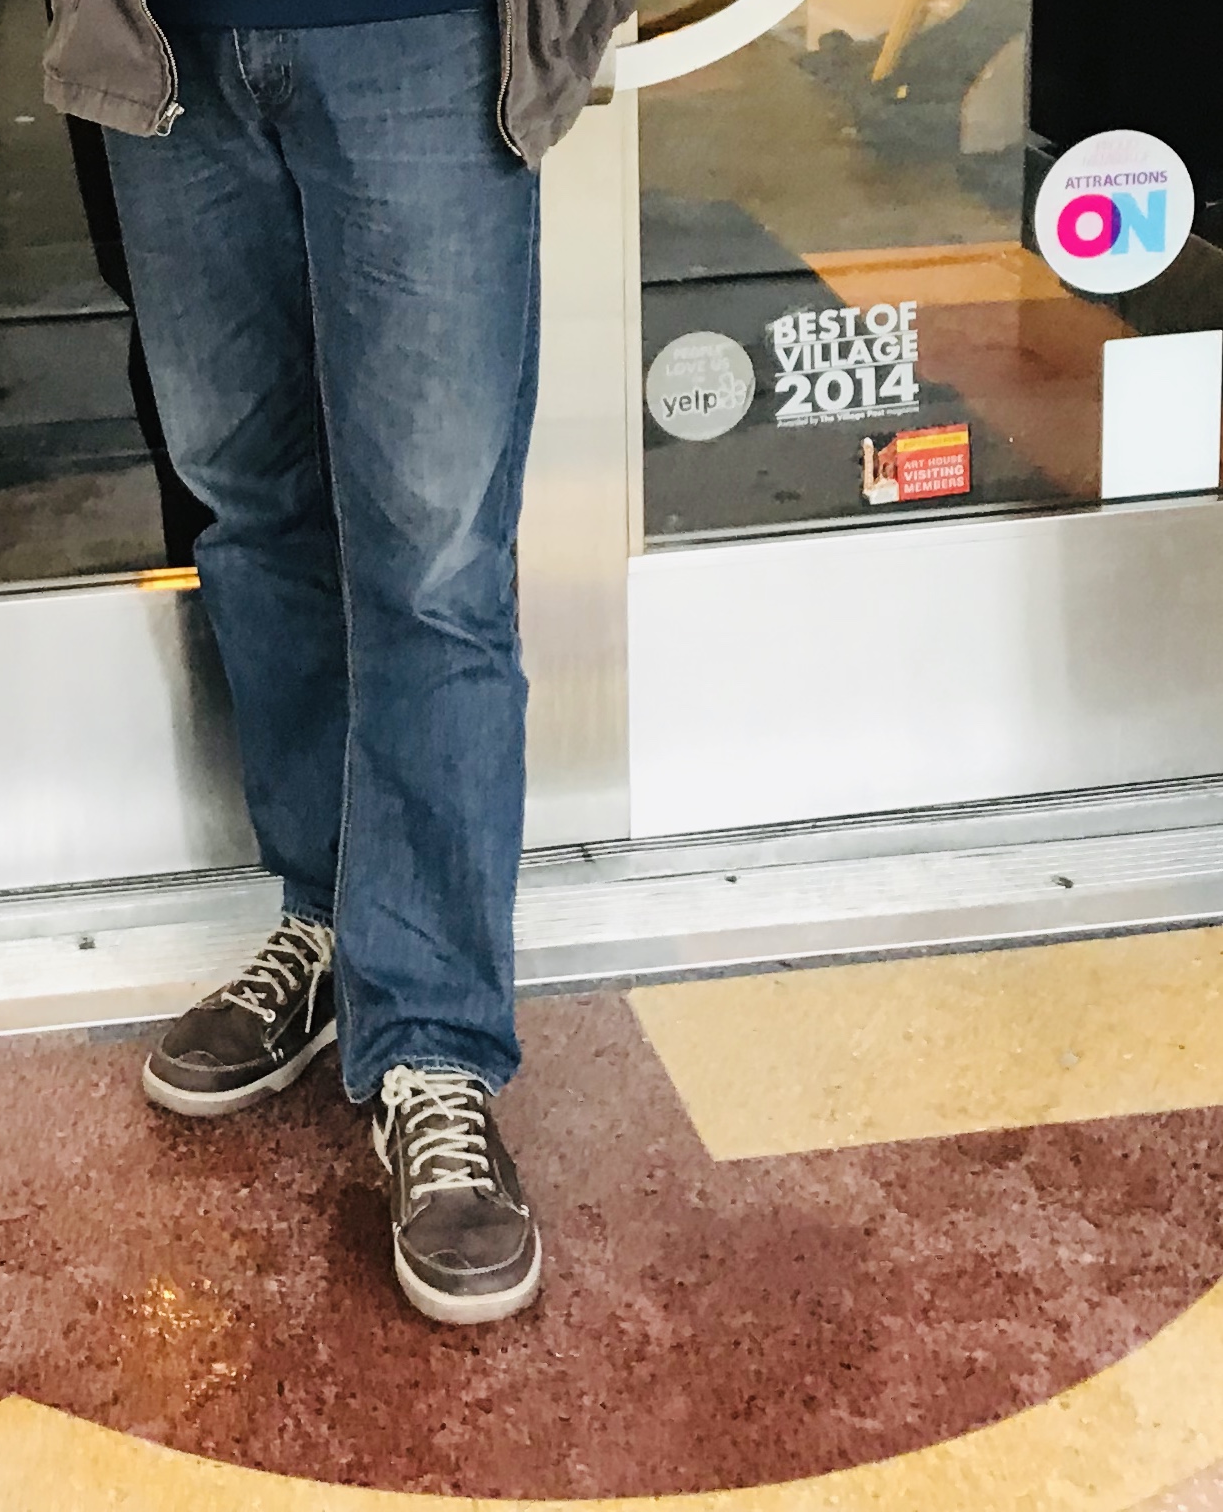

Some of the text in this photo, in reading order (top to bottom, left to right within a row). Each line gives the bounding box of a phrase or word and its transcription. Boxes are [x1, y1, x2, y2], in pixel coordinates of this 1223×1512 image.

[1065, 170, 1168, 190] ATTRACTIONS
[1057, 189, 1167, 259] ON
[774, 300, 918, 344] BEST OF
[775, 331, 919, 373] VILLAGE
[775, 360, 919, 417] 2014
[662, 389, 718, 418] yelp
[903, 460, 926, 470] ART
[904, 465, 964, 481] VISITING
[904, 477, 964, 494] MEMBERS
